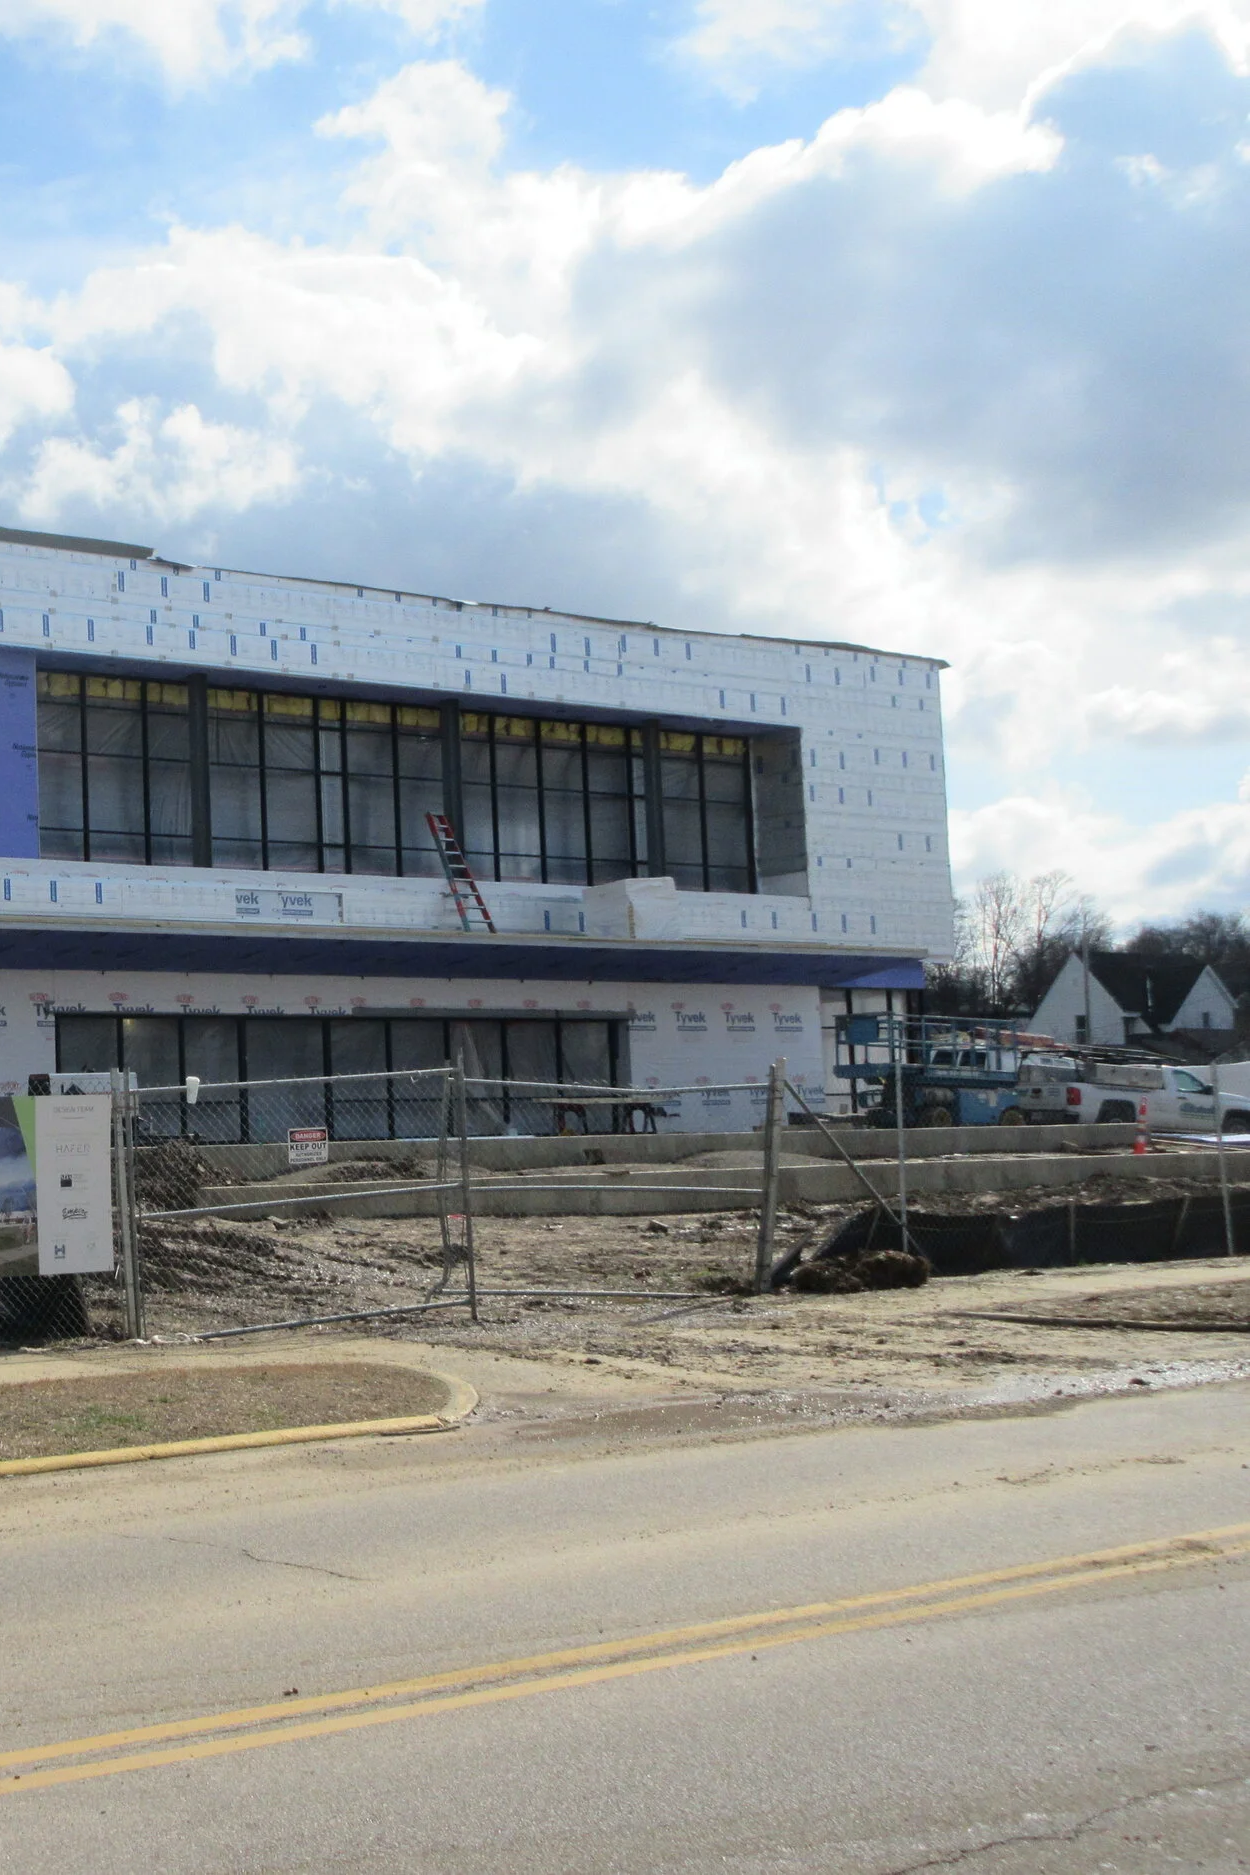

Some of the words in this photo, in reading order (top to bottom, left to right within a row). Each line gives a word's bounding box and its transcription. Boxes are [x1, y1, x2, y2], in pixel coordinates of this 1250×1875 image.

[278, 893, 312, 908] yvek
[675, 1011, 706, 1024] Tyvek
[724, 1012, 754, 1025] Tyvek
[772, 1013, 801, 1025] Tyvek
[290, 1143, 309, 1151] KEEP
